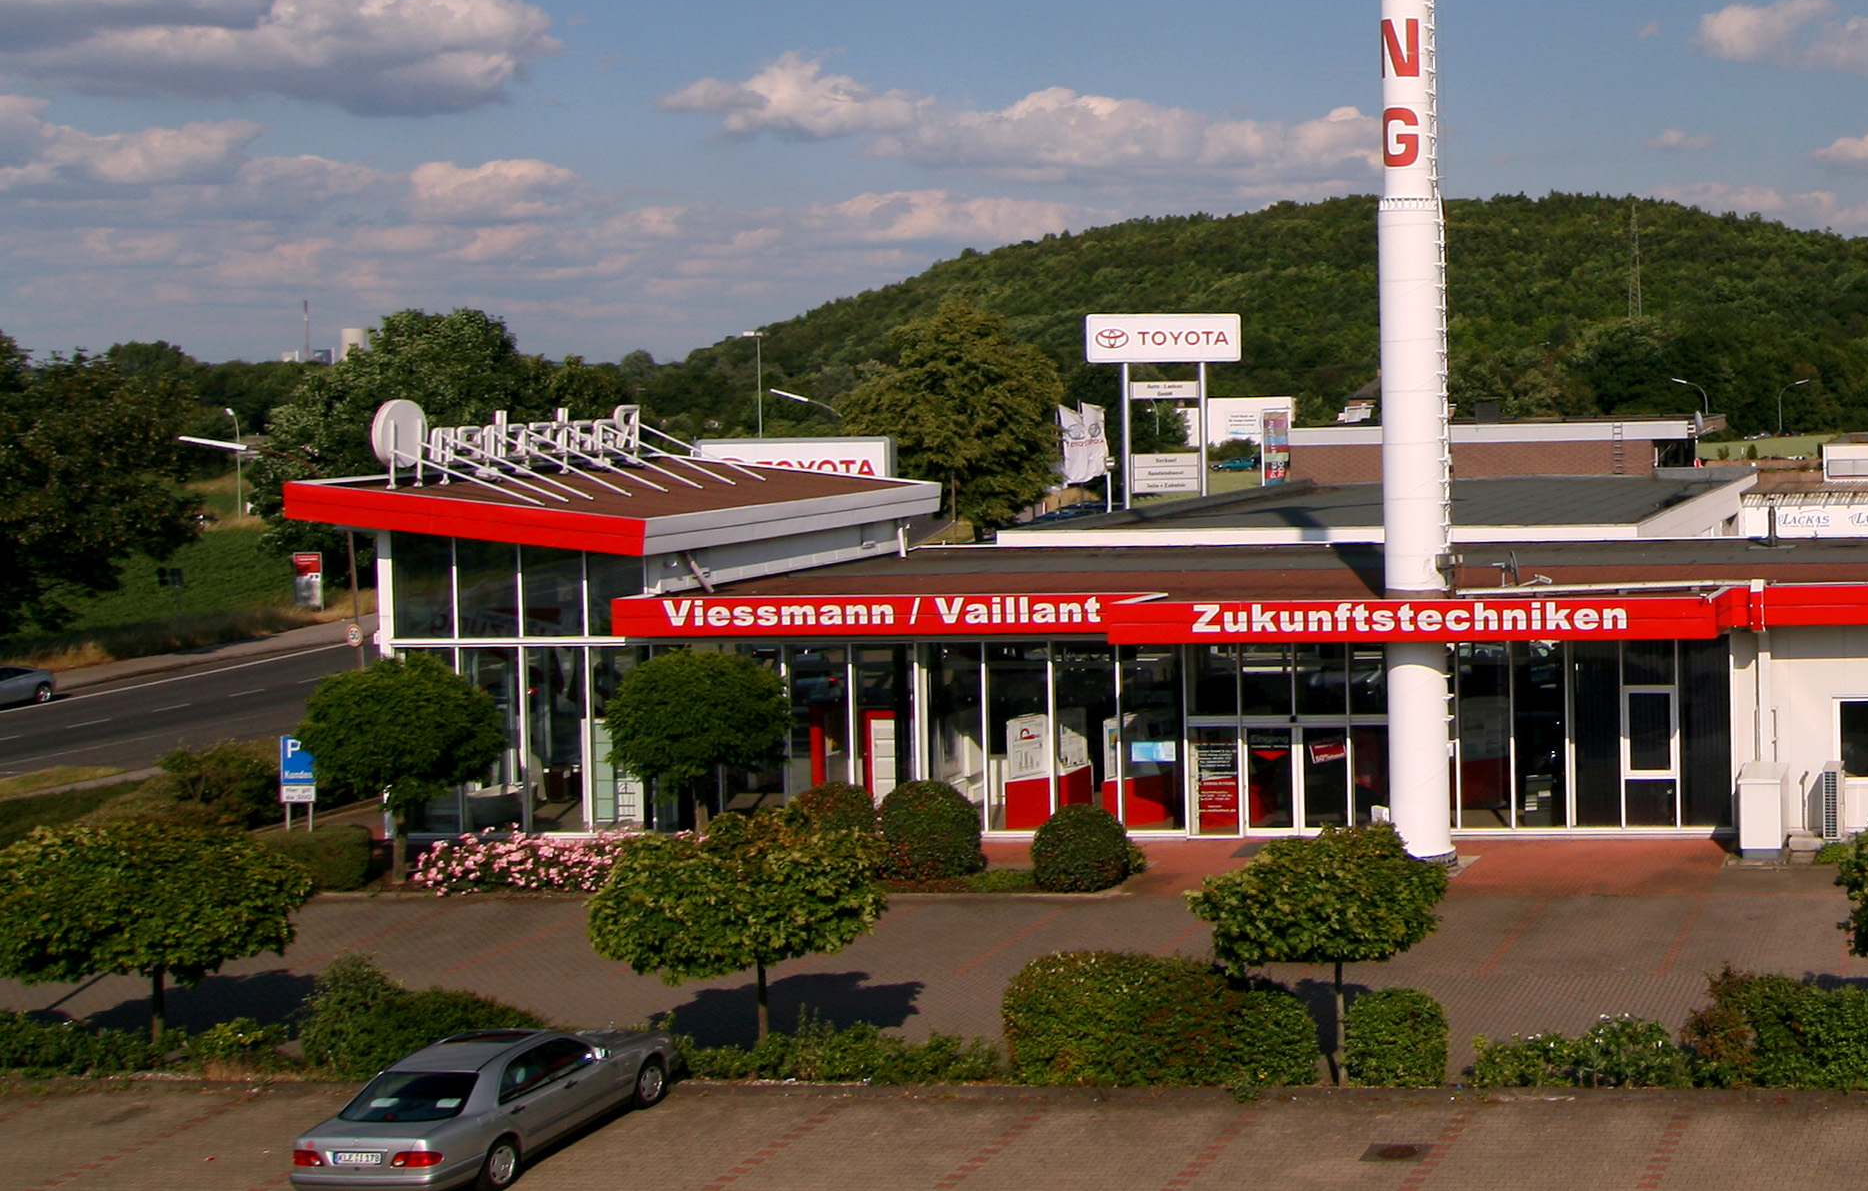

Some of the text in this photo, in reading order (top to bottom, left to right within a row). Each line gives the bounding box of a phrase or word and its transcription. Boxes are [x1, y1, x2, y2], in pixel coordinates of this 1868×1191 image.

[1136, 331, 1230, 346] TOYOTA
[1782, 513, 1830, 525] LACKAS
[662, 596, 1102, 627] Viessmann / Vaillant
[1192, 601, 1628, 633] Zukunftstechniken
[286, 738, 302, 759] P
